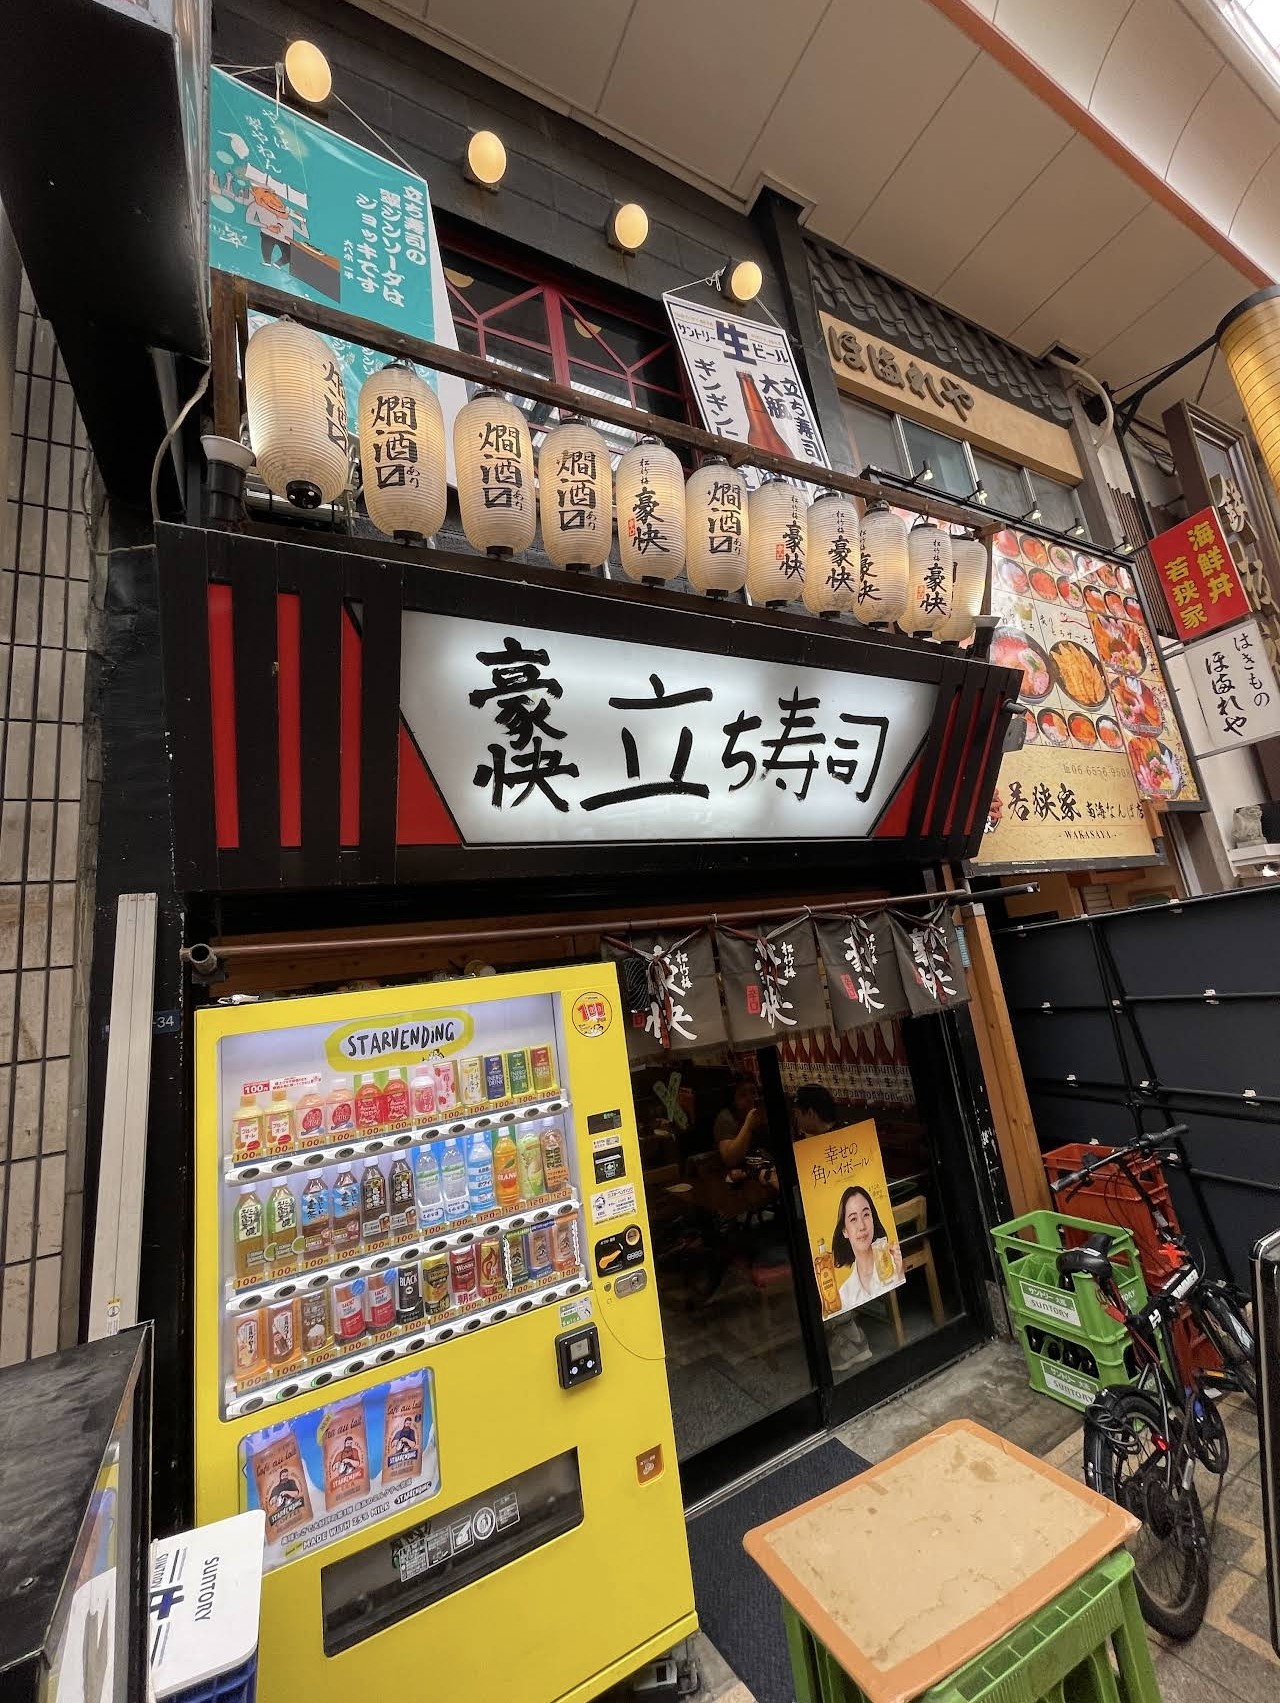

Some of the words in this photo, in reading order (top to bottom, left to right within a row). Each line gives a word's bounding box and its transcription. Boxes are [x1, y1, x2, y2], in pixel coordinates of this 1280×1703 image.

[678, 323, 716, 342] サントリー
[716, 320, 757, 365] 生
[753, 343, 789, 363] ビール
[632, 487, 670, 554] 豪快
[779, 520, 805, 584] 豪快
[825, 535, 855, 593] 豪快
[1187, 520, 1234, 604] 海鮮丼
[920, 563, 947, 615] 豪快
[1164, 556, 1208, 630] 若狭家
[1233, 632, 1271, 706] はきもの
[469, 636, 579, 812] 豪快
[580, 673, 890, 810] 立ち寿司
[676, 950, 693, 989] 松竹梅
[781, 942, 797, 978] 松竹梅
[811, 1157, 870, 1188] 角ハイボール
[824, 1142, 858, 1165] 幸せの
[400, 1275, 418, 1287] BLACK
[302, 1534, 329, 1551] MADE
[329, 1523, 350, 1538] WITH
[370, 1502, 390, 1518] MILK
[195, 1556, 220, 1622] SUNTORY
